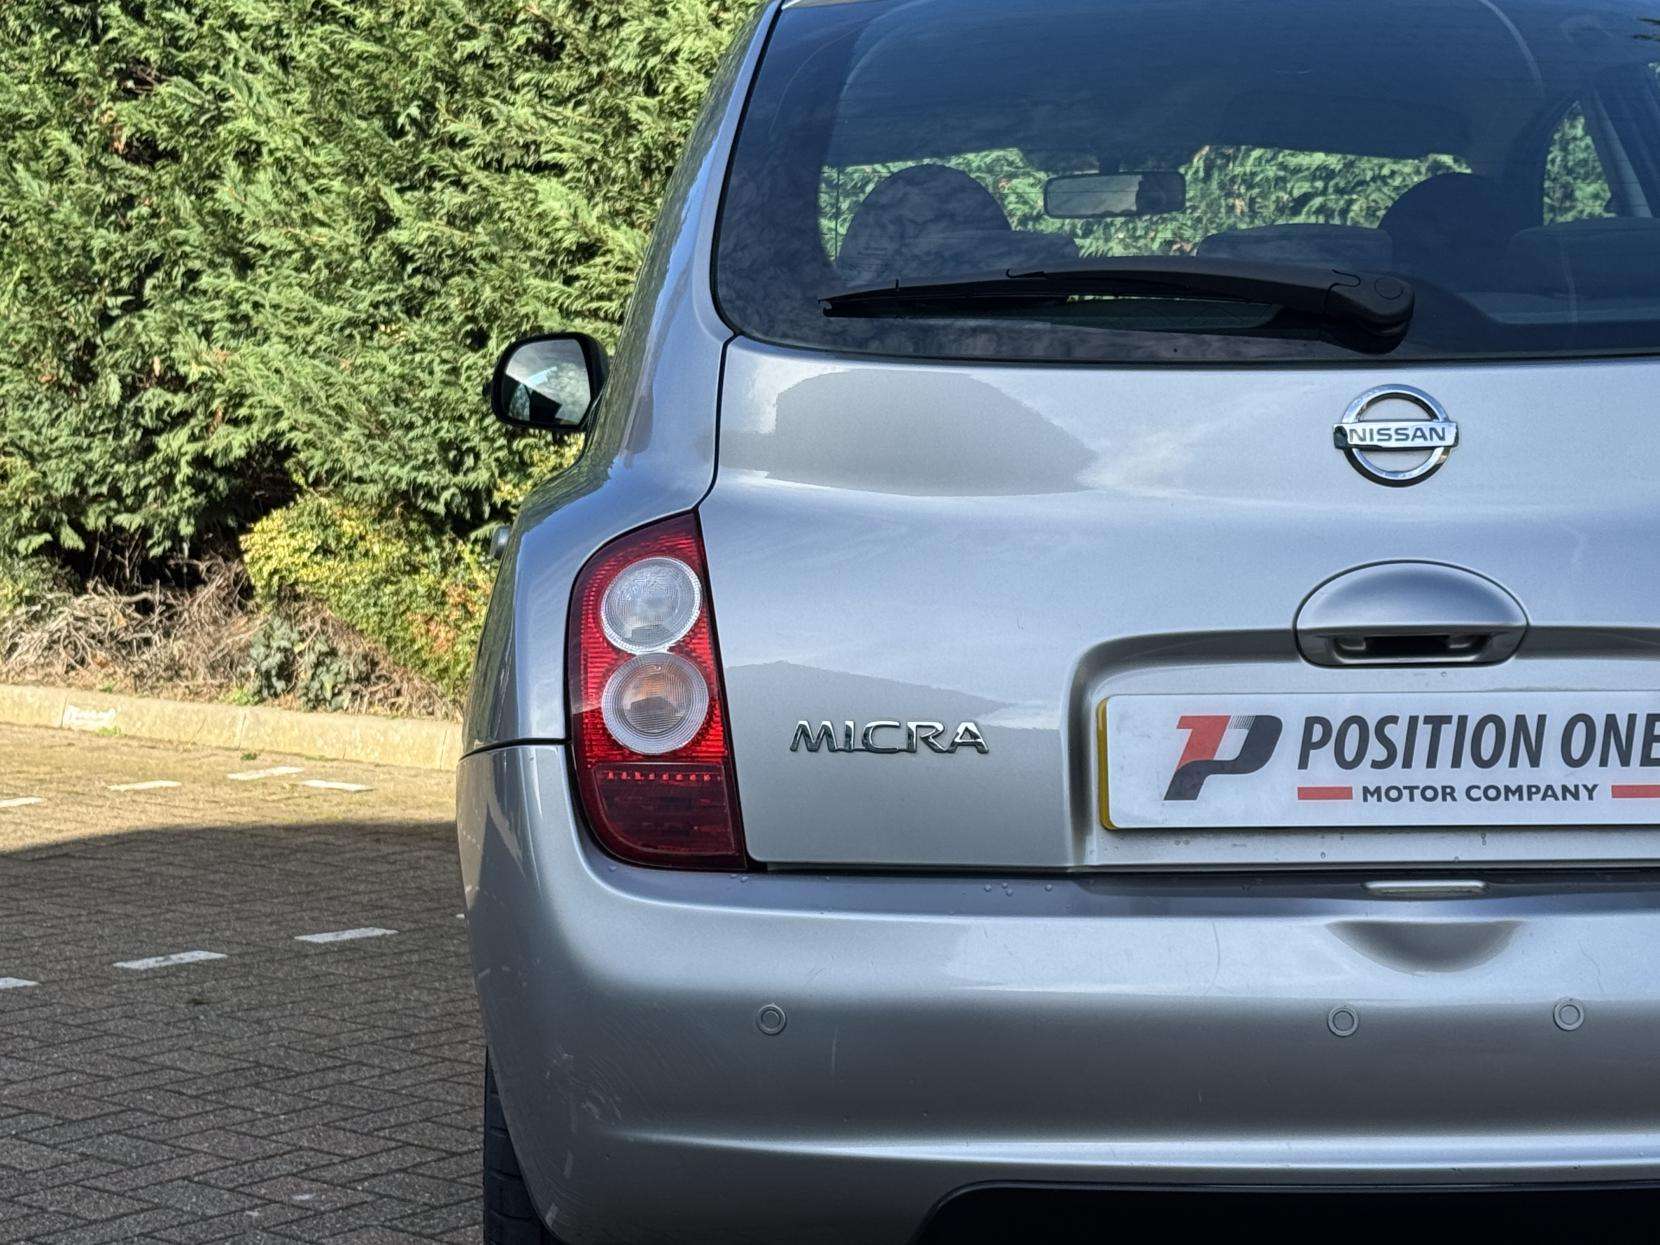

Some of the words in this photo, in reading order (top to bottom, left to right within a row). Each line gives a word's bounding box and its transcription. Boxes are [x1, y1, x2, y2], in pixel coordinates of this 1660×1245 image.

[1349, 427, 1446, 442] NISSAN
[789, 720, 990, 754] MICRA
[1297, 714, 1547, 770] POSITION
[1560, 713, 1660, 768] ONE
[1362, 785, 1457, 803] MOTOR
[1465, 784, 1599, 802] COMPANY
